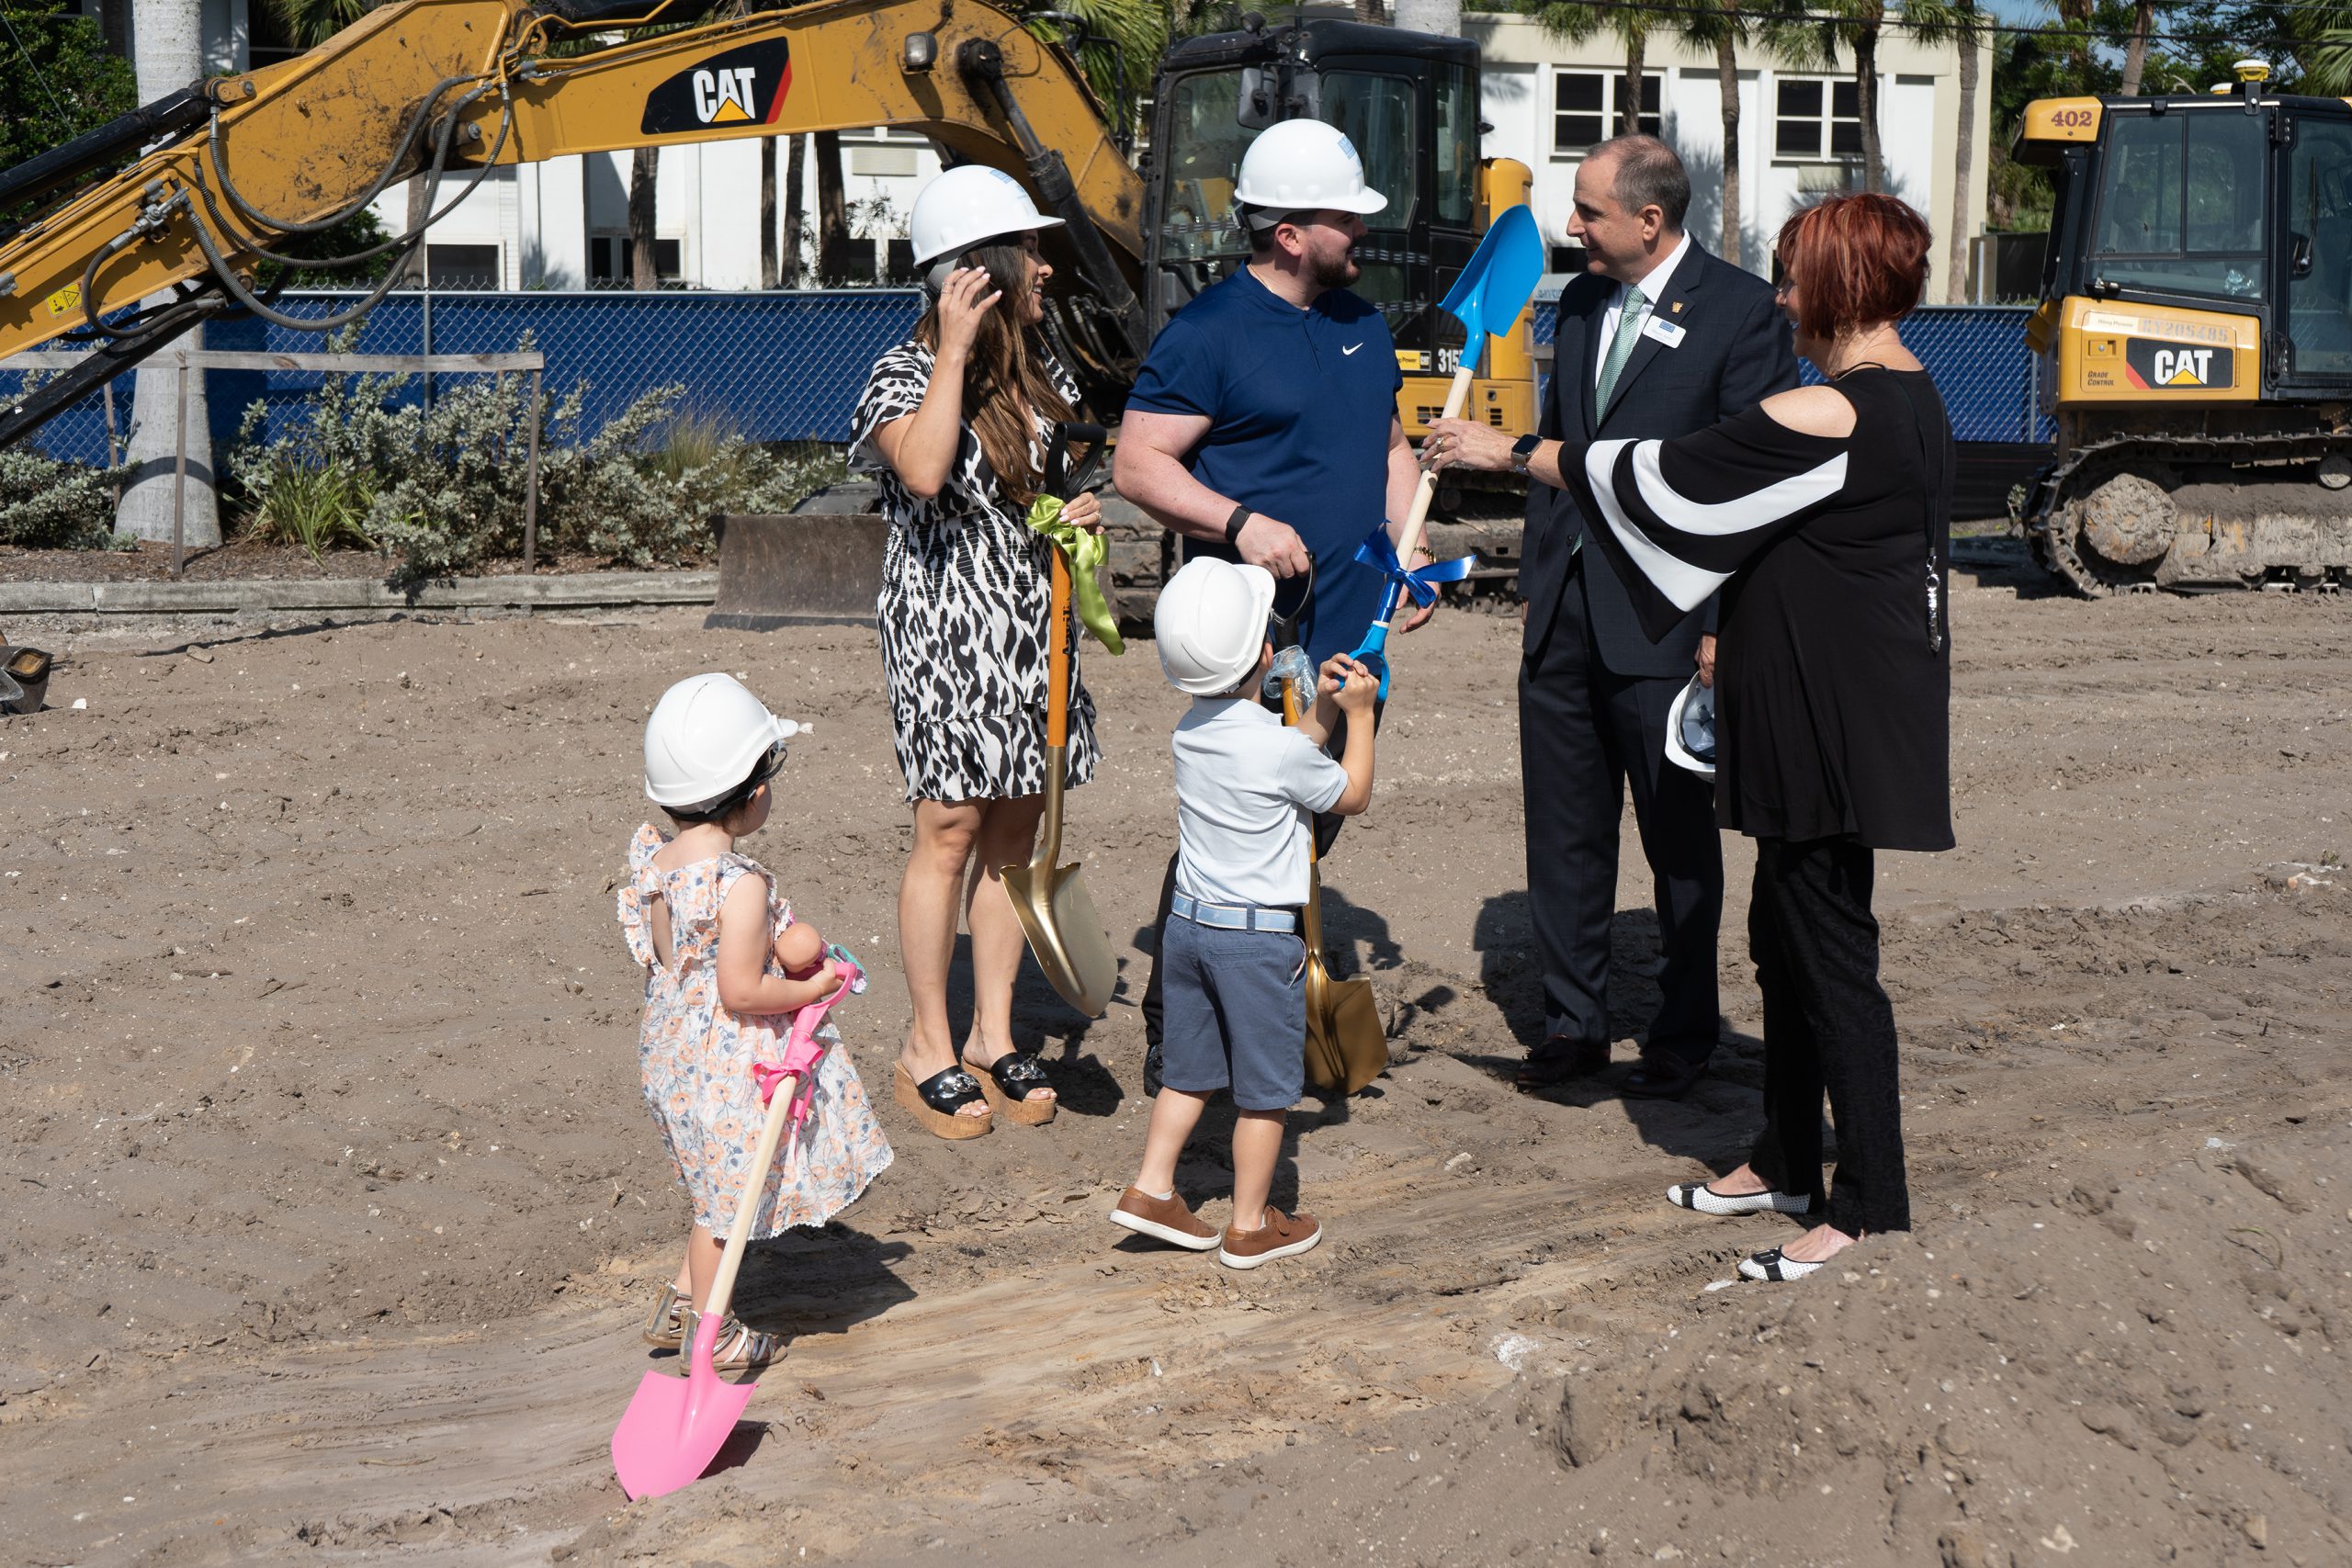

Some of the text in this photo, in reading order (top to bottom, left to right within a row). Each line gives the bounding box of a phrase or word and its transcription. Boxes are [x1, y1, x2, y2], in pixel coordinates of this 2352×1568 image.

[693, 67, 756, 123] CAT
[2051, 110, 2092, 127] 402
[2087, 370, 2109, 378] GRADE
[2154, 349, 2213, 385] CAT
